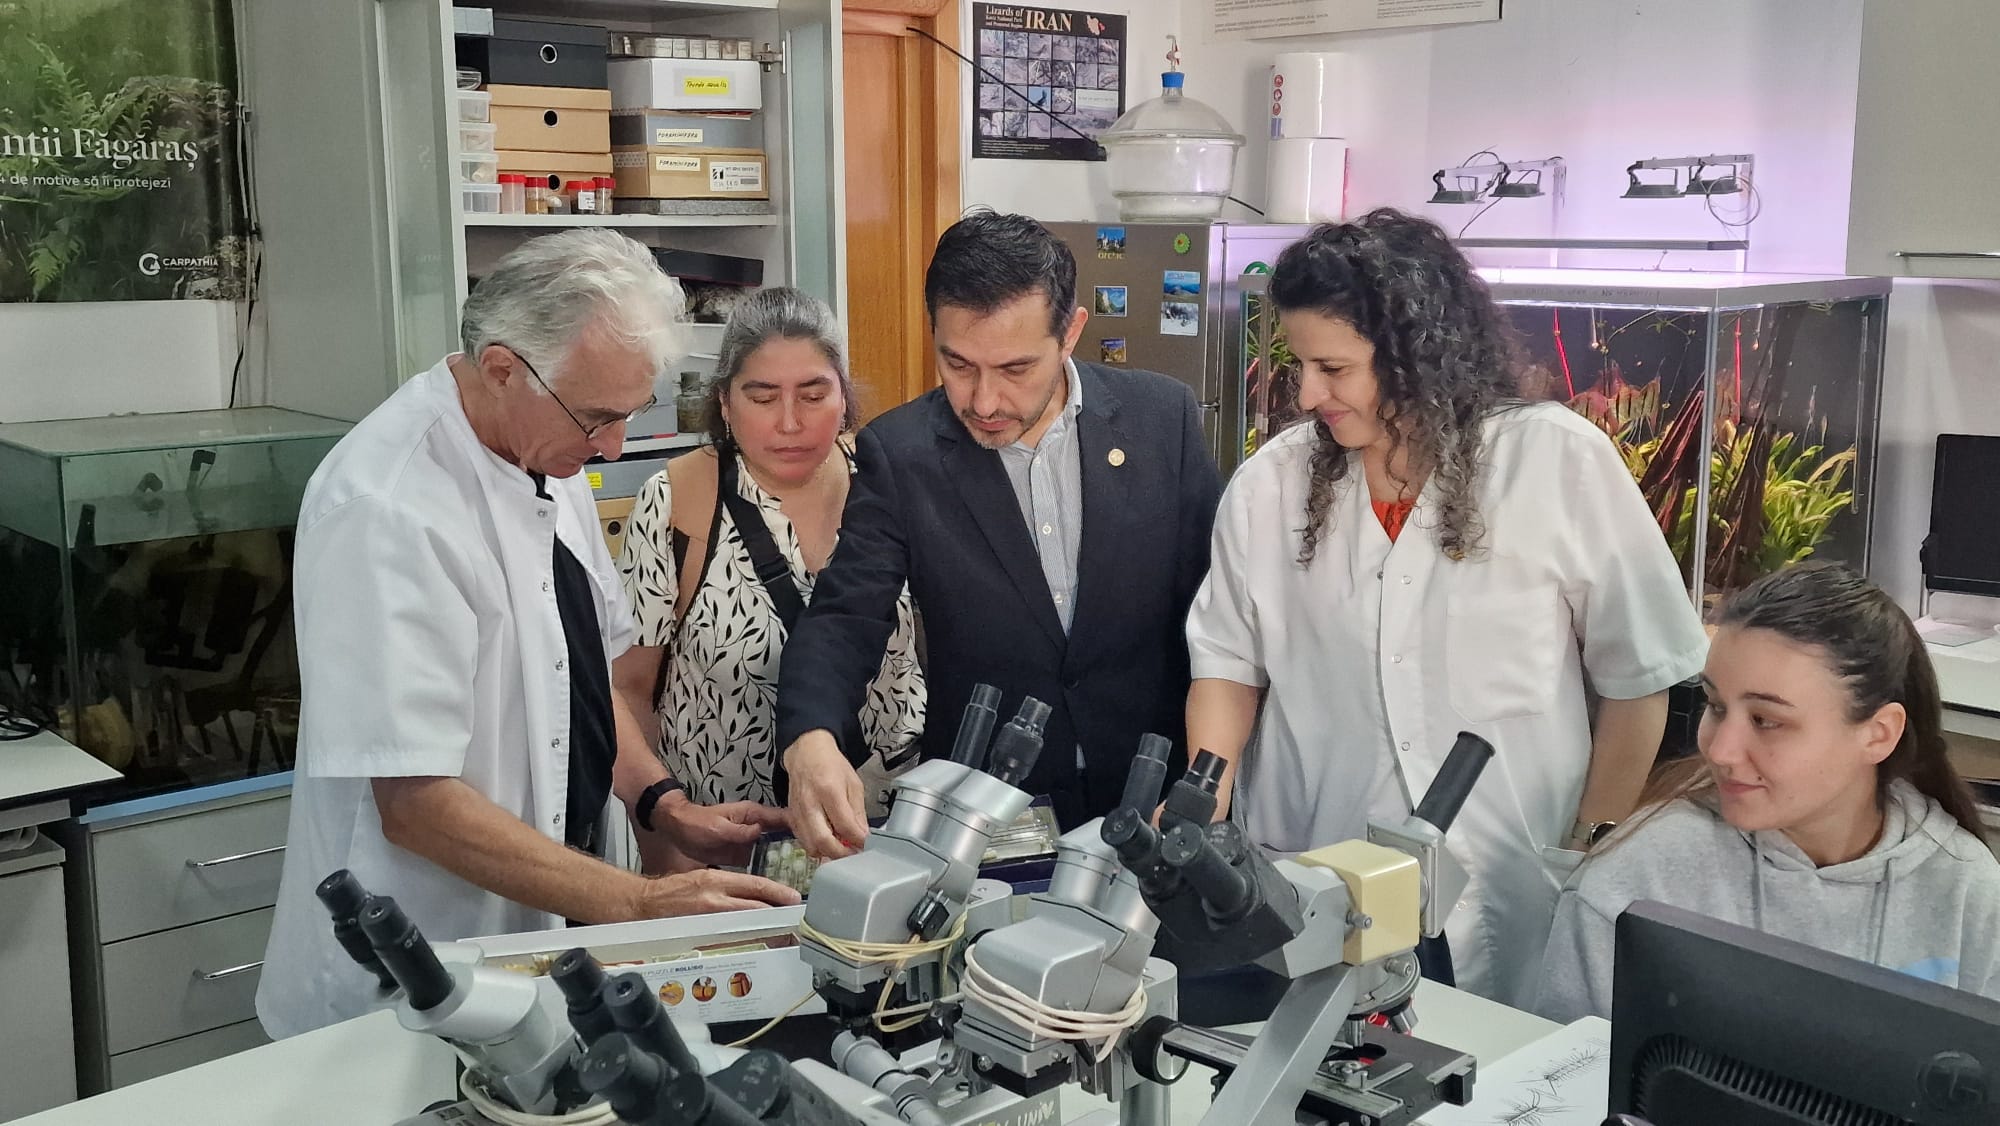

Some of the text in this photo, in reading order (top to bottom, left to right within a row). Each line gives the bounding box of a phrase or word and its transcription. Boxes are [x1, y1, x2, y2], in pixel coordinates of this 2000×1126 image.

[986, 5, 1073, 31] Lizards of IRAN
[0, 126, 199, 172] nții Făgăraș
[10, 174, 28, 186] de
[33, 174, 80, 187] motive
[83, 175, 99, 187] să
[113, 176, 171, 191] protejezi
[162, 257, 219, 267] CARPATHIA
